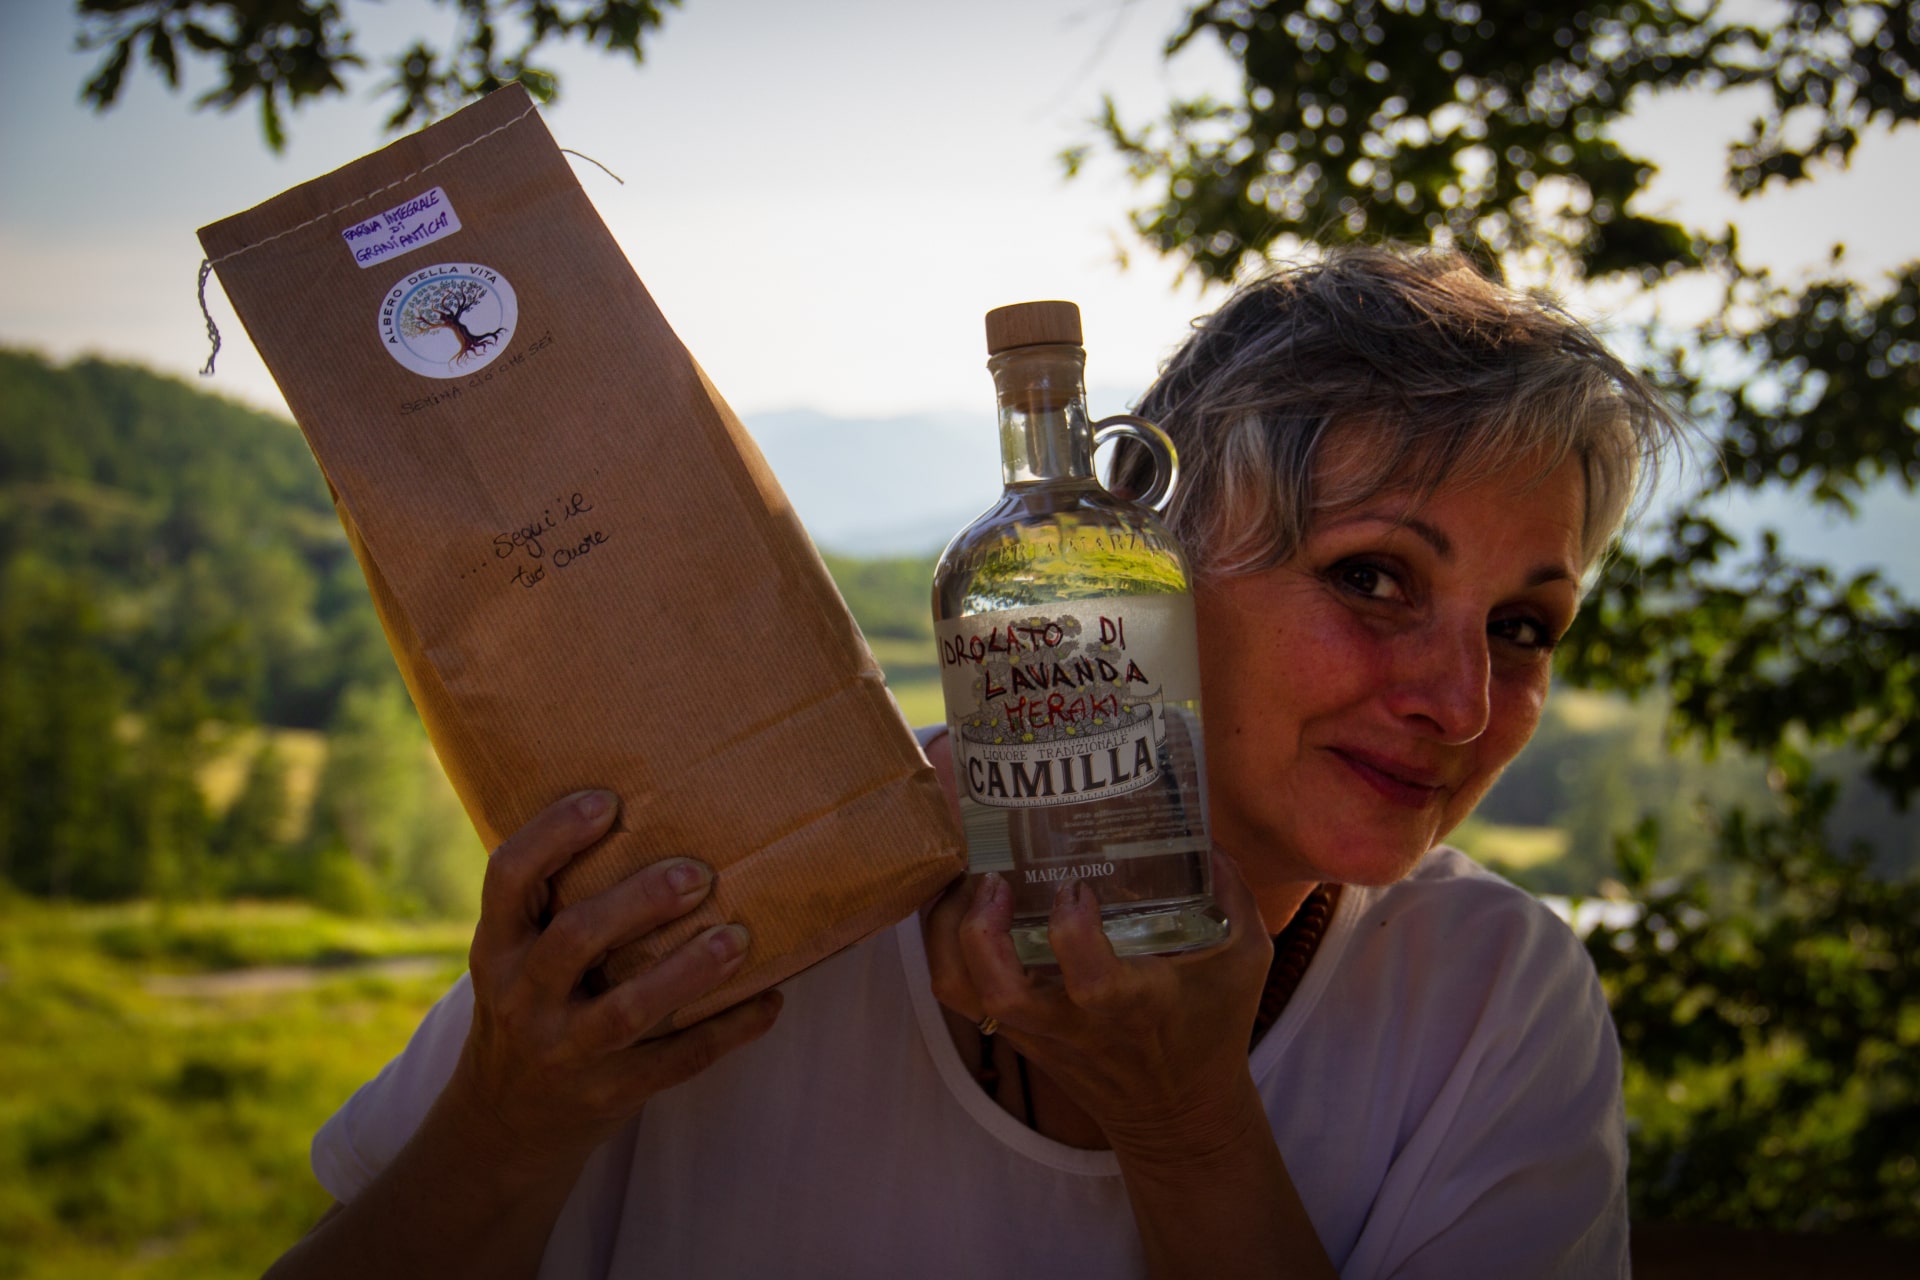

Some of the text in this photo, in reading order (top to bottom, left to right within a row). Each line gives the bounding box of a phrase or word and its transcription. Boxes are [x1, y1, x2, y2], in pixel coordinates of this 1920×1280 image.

[343, 190, 440, 241] FARINA INTEGRALE
[383, 266, 497, 344] ALBERO DELLA VITA
[510, 564, 545, 588] tuo
[940, 615, 1127, 669] IDROLATO DI
[984, 655, 1149, 700] LAVANDA
[1004, 693, 1119, 733] MERAKI
[968, 736, 1155, 798] CAMILLA
[983, 734, 1129, 761] LIQUORE TRADIZIONALE
[1024, 861, 1115, 884] MARZADRO
